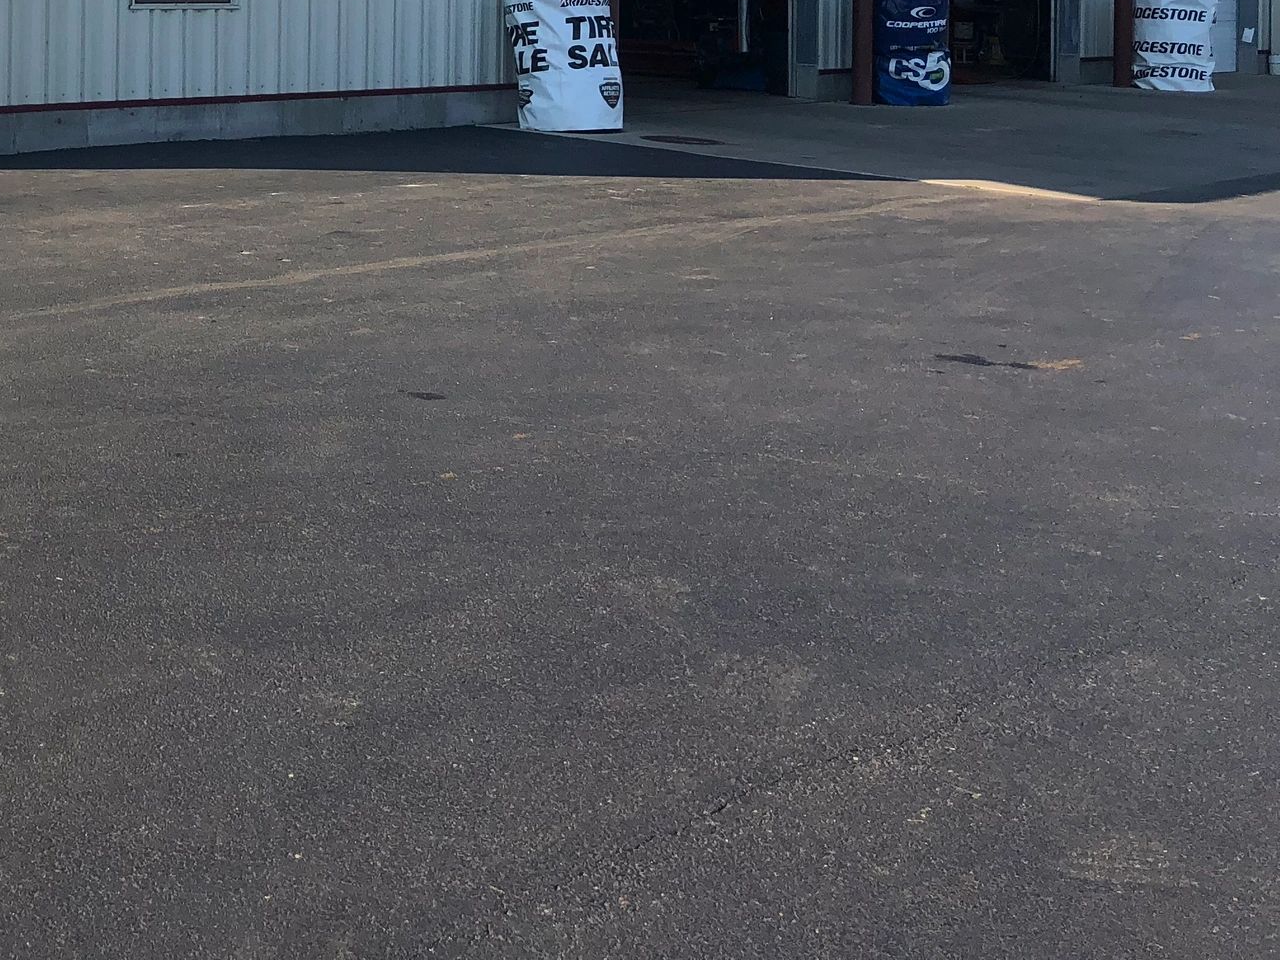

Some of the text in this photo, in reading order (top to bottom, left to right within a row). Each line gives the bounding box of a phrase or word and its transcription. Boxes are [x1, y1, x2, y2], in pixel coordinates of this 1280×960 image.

[1133, 7, 1208, 23] DGESTONE
[567, 43, 620, 70] SAL
[888, 51, 951, 91] CS5
